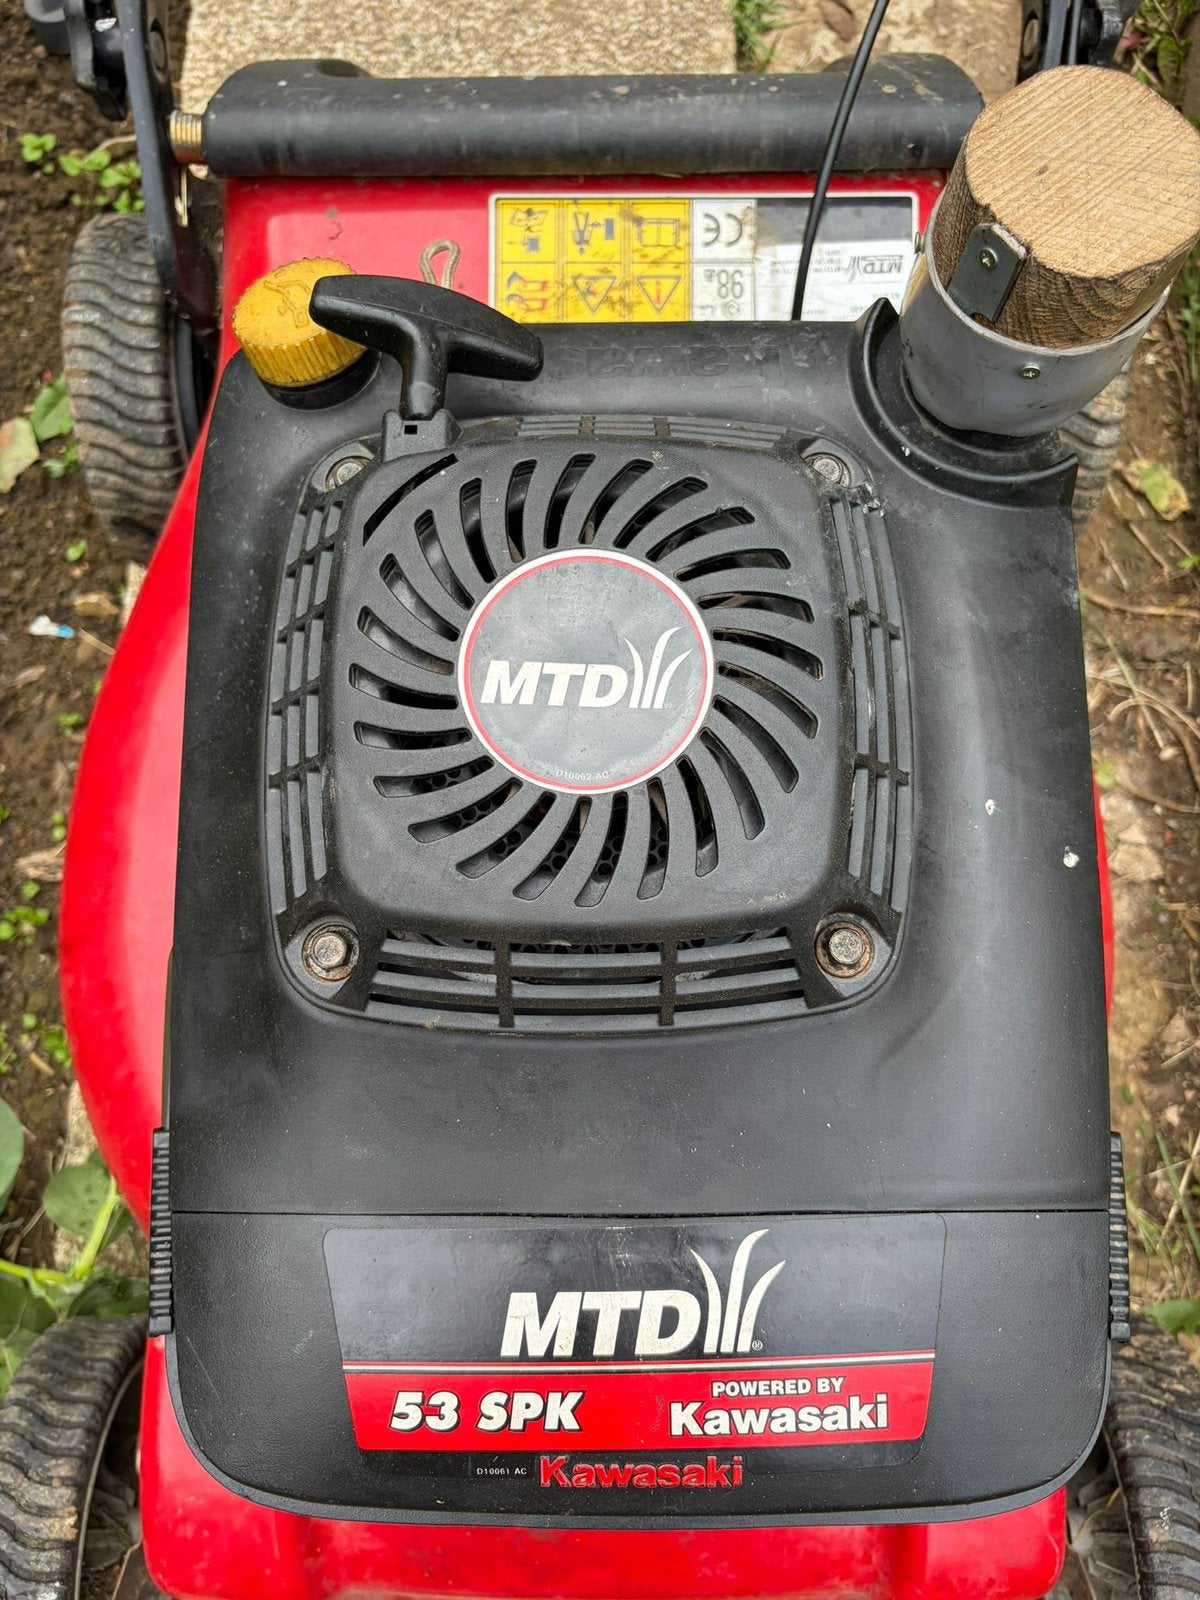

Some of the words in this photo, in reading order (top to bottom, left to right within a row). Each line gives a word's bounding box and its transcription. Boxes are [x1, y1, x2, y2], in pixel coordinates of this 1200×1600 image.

[717, 269, 743, 299] 98
[502, 345, 784, 388] Kawas
[480, 660, 629, 708] MTD
[555, 769, 592, 781] D10062
[595, 771, 610, 780] AC
[500, 1289, 701, 1357] MTD
[711, 1378, 812, 1398] POWERED
[816, 1376, 846, 1394] BY
[389, 1390, 461, 1432] 53
[475, 1390, 586, 1432] SPK
[669, 1392, 889, 1438] Kawasaki
[476, 1467, 510, 1476] D10061
[514, 1467, 527, 1476] AC
[538, 1454, 744, 1489] Kawasaki
